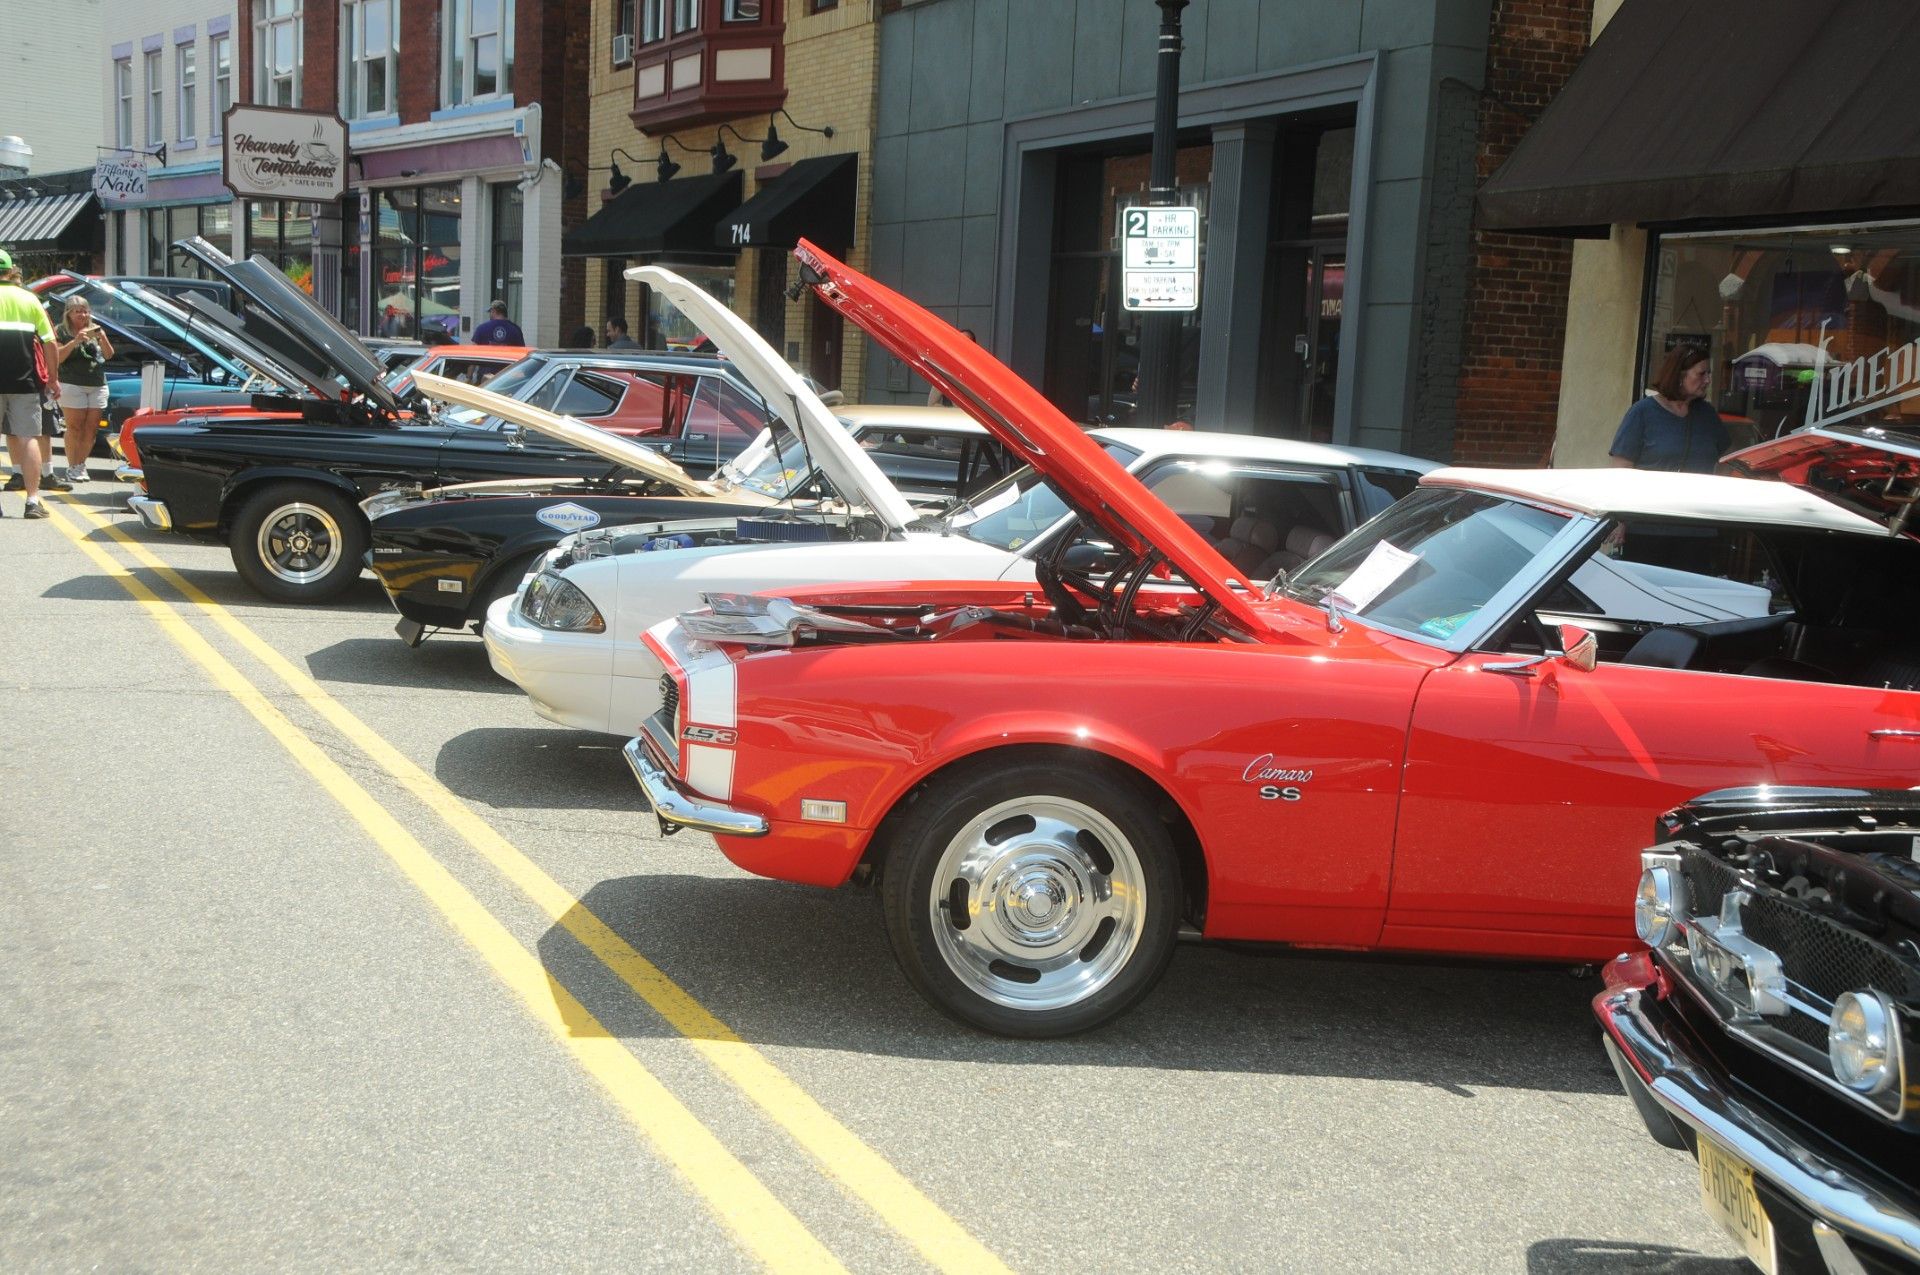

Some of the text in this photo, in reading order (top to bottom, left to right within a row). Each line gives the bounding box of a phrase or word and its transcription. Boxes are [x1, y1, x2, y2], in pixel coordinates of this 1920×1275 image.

[233, 133, 300, 159] Heavenly
[101, 163, 134, 178] Tiffany
[251, 156, 336, 179] Temptations
[100, 176, 144, 193] Nails
[1129, 212, 1146, 235] 2
[1164, 214, 1177, 222] HR
[731, 223, 750, 244] 714
[1152, 226, 1190, 235] PARKING
[683, 726, 737, 744] LS3
[1243, 752, 1313, 782] Camaro
[1260, 785, 1301, 801] SS
